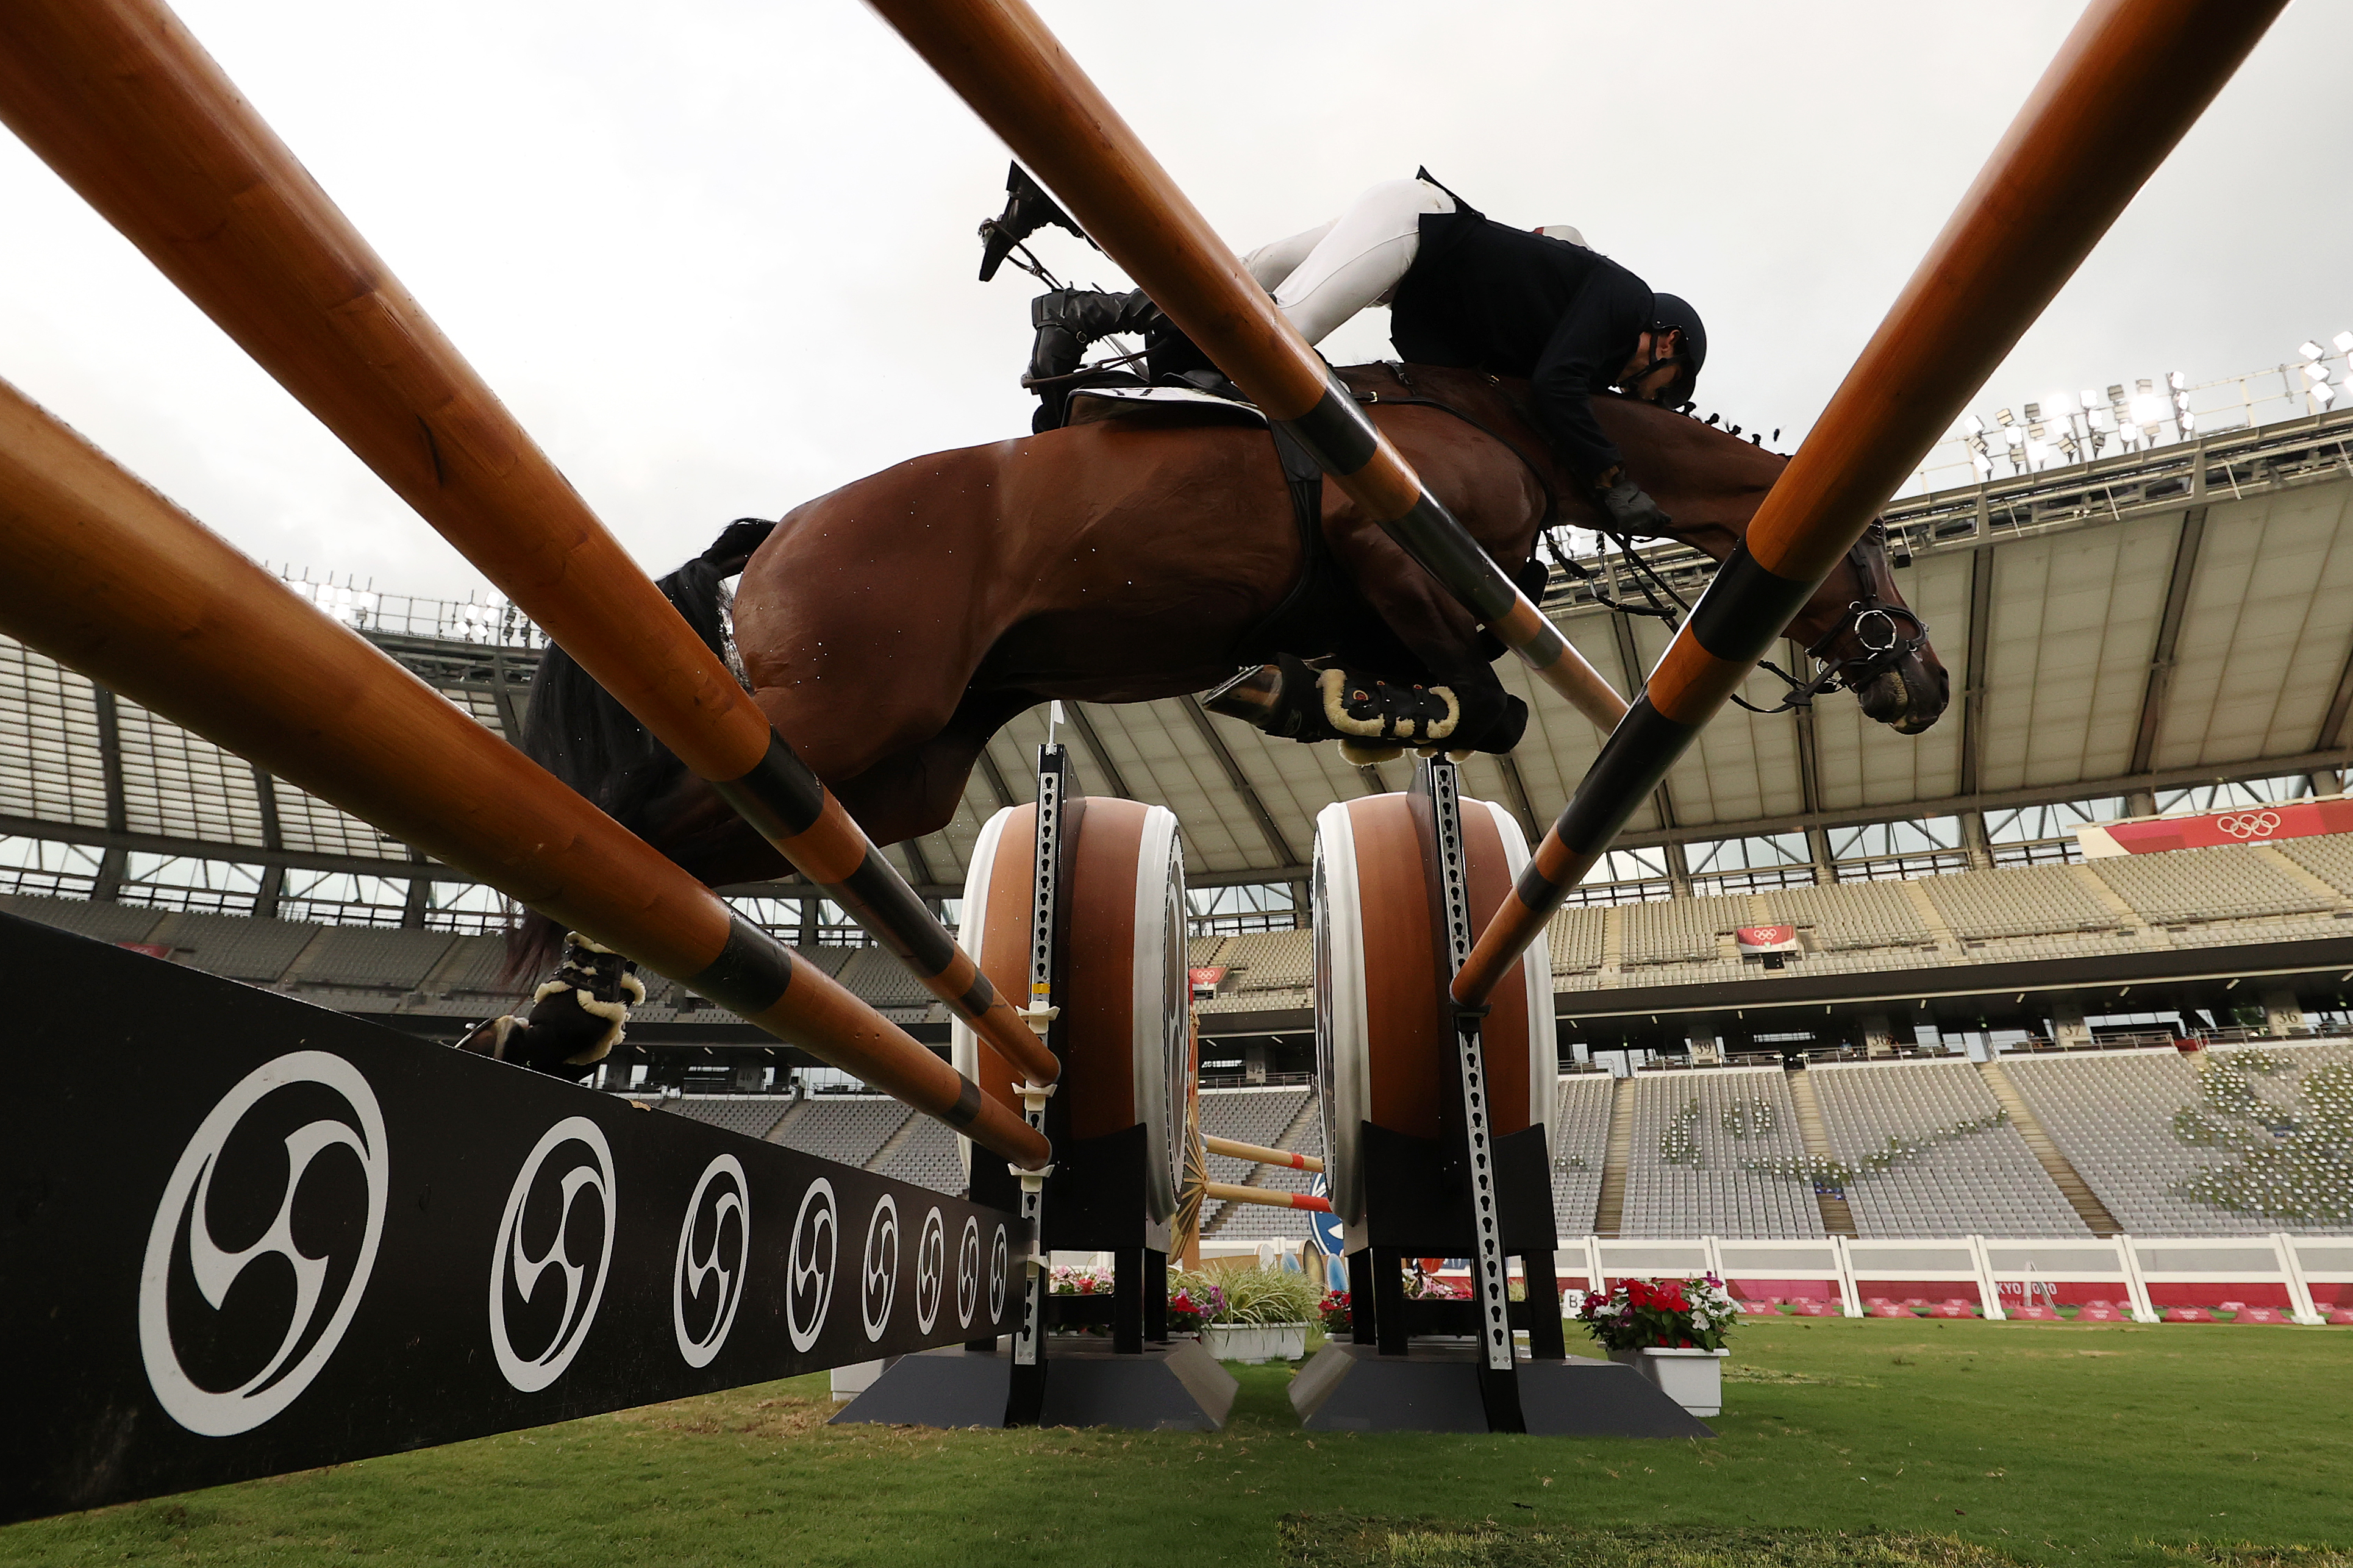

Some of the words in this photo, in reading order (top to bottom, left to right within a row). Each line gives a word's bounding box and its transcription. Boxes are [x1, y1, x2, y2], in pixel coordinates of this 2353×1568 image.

[2276, 1011, 2298, 1024] 36
[2065, 1024, 2080, 1036] 37
[1695, 1042, 1712, 1055] 39
[1996, 1282, 2022, 1295] KYO
[1569, 1295, 1578, 1308] B
